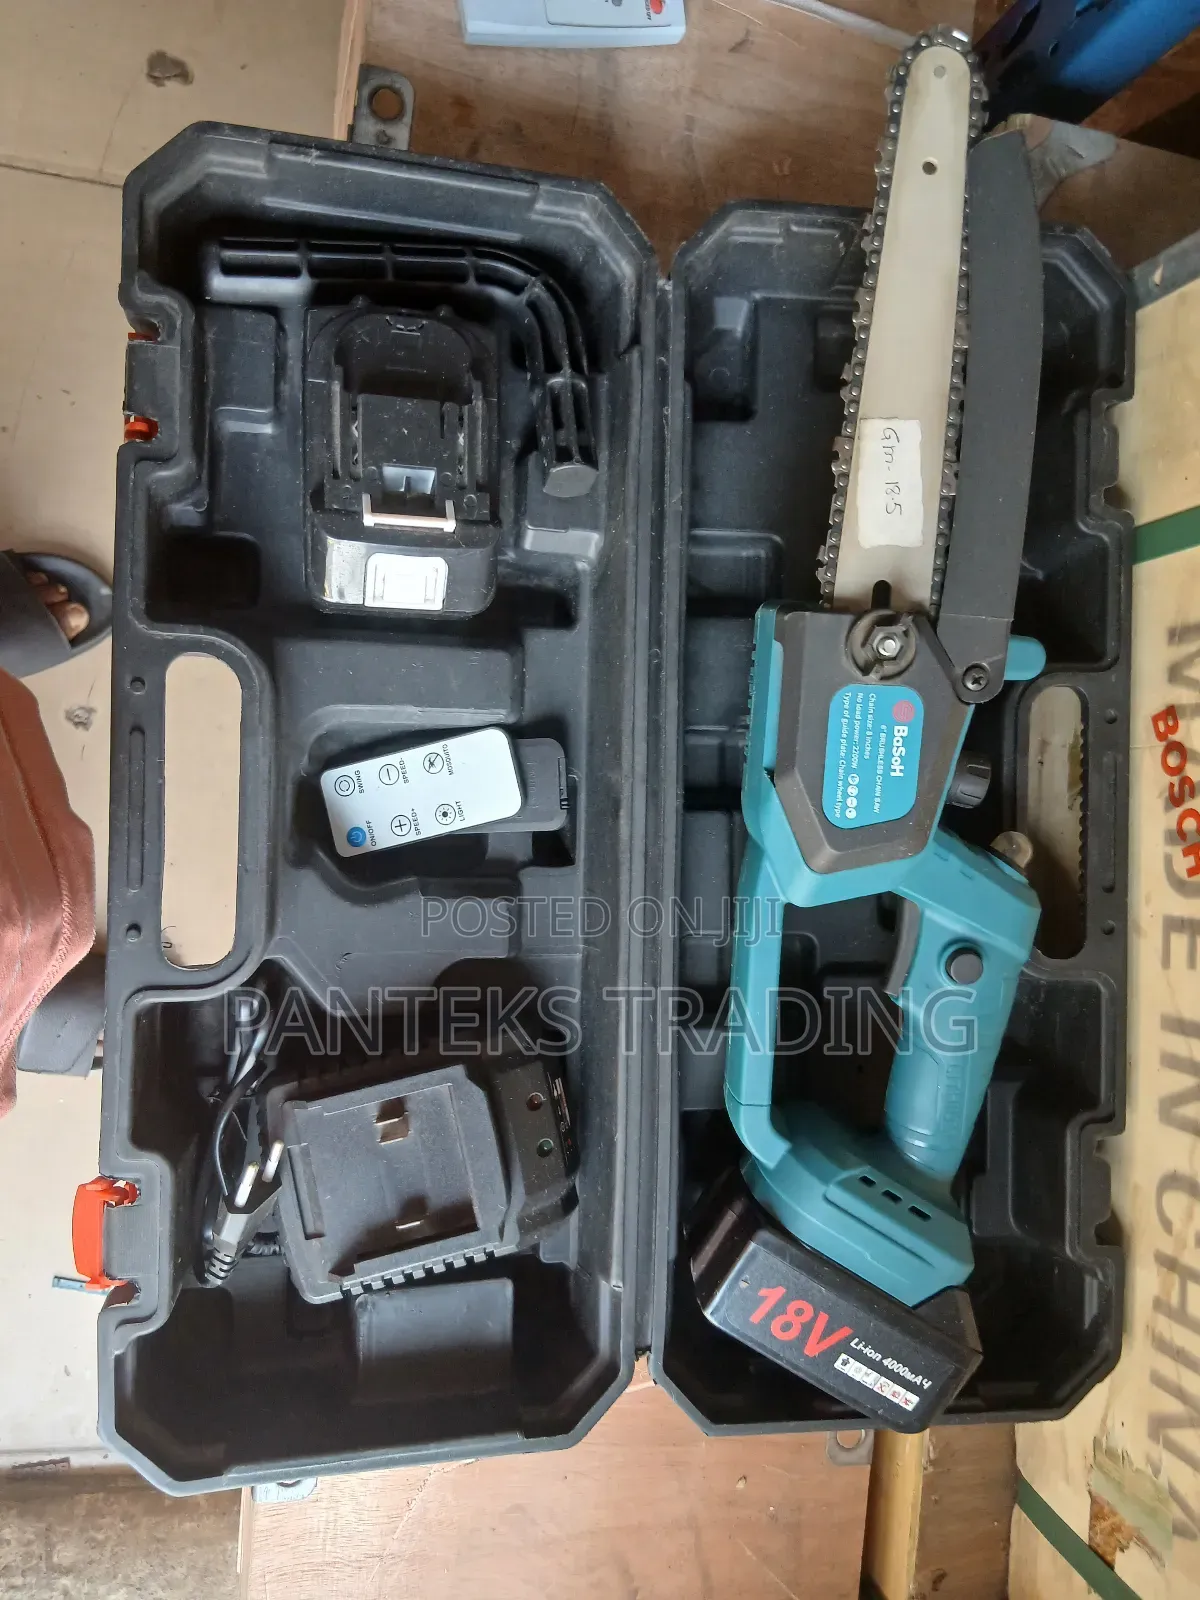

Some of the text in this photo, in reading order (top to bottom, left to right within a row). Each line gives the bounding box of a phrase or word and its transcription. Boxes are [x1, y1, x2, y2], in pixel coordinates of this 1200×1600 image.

[868, 693, 876, 714] Chain
[851, 692, 864, 769] No load power: 2200W
[866, 714, 875, 731] size:
[442, 743, 454, 776] MOSQUITO
[834, 692, 851, 819] Type of guide plate: Chain wheel type
[864, 736, 873, 760] inches
[877, 732, 886, 775] BRUSHLESS
[890, 725, 909, 777] BaSoH
[354, 769, 365, 794] SWING
[399, 757, 410, 784] SPEED-
[875, 775, 883, 797] CHAIN
[1151, 704, 1200, 879] BOSCH
[455, 800, 466, 822] LIGHT
[873, 797, 881, 814] SAW
[365, 819, 377, 847] ON/OFF
[411, 807, 422, 836] SPEED+
[749, 1285, 854, 1357] 18V
[850, 1337, 883, 1362] Li-ion
